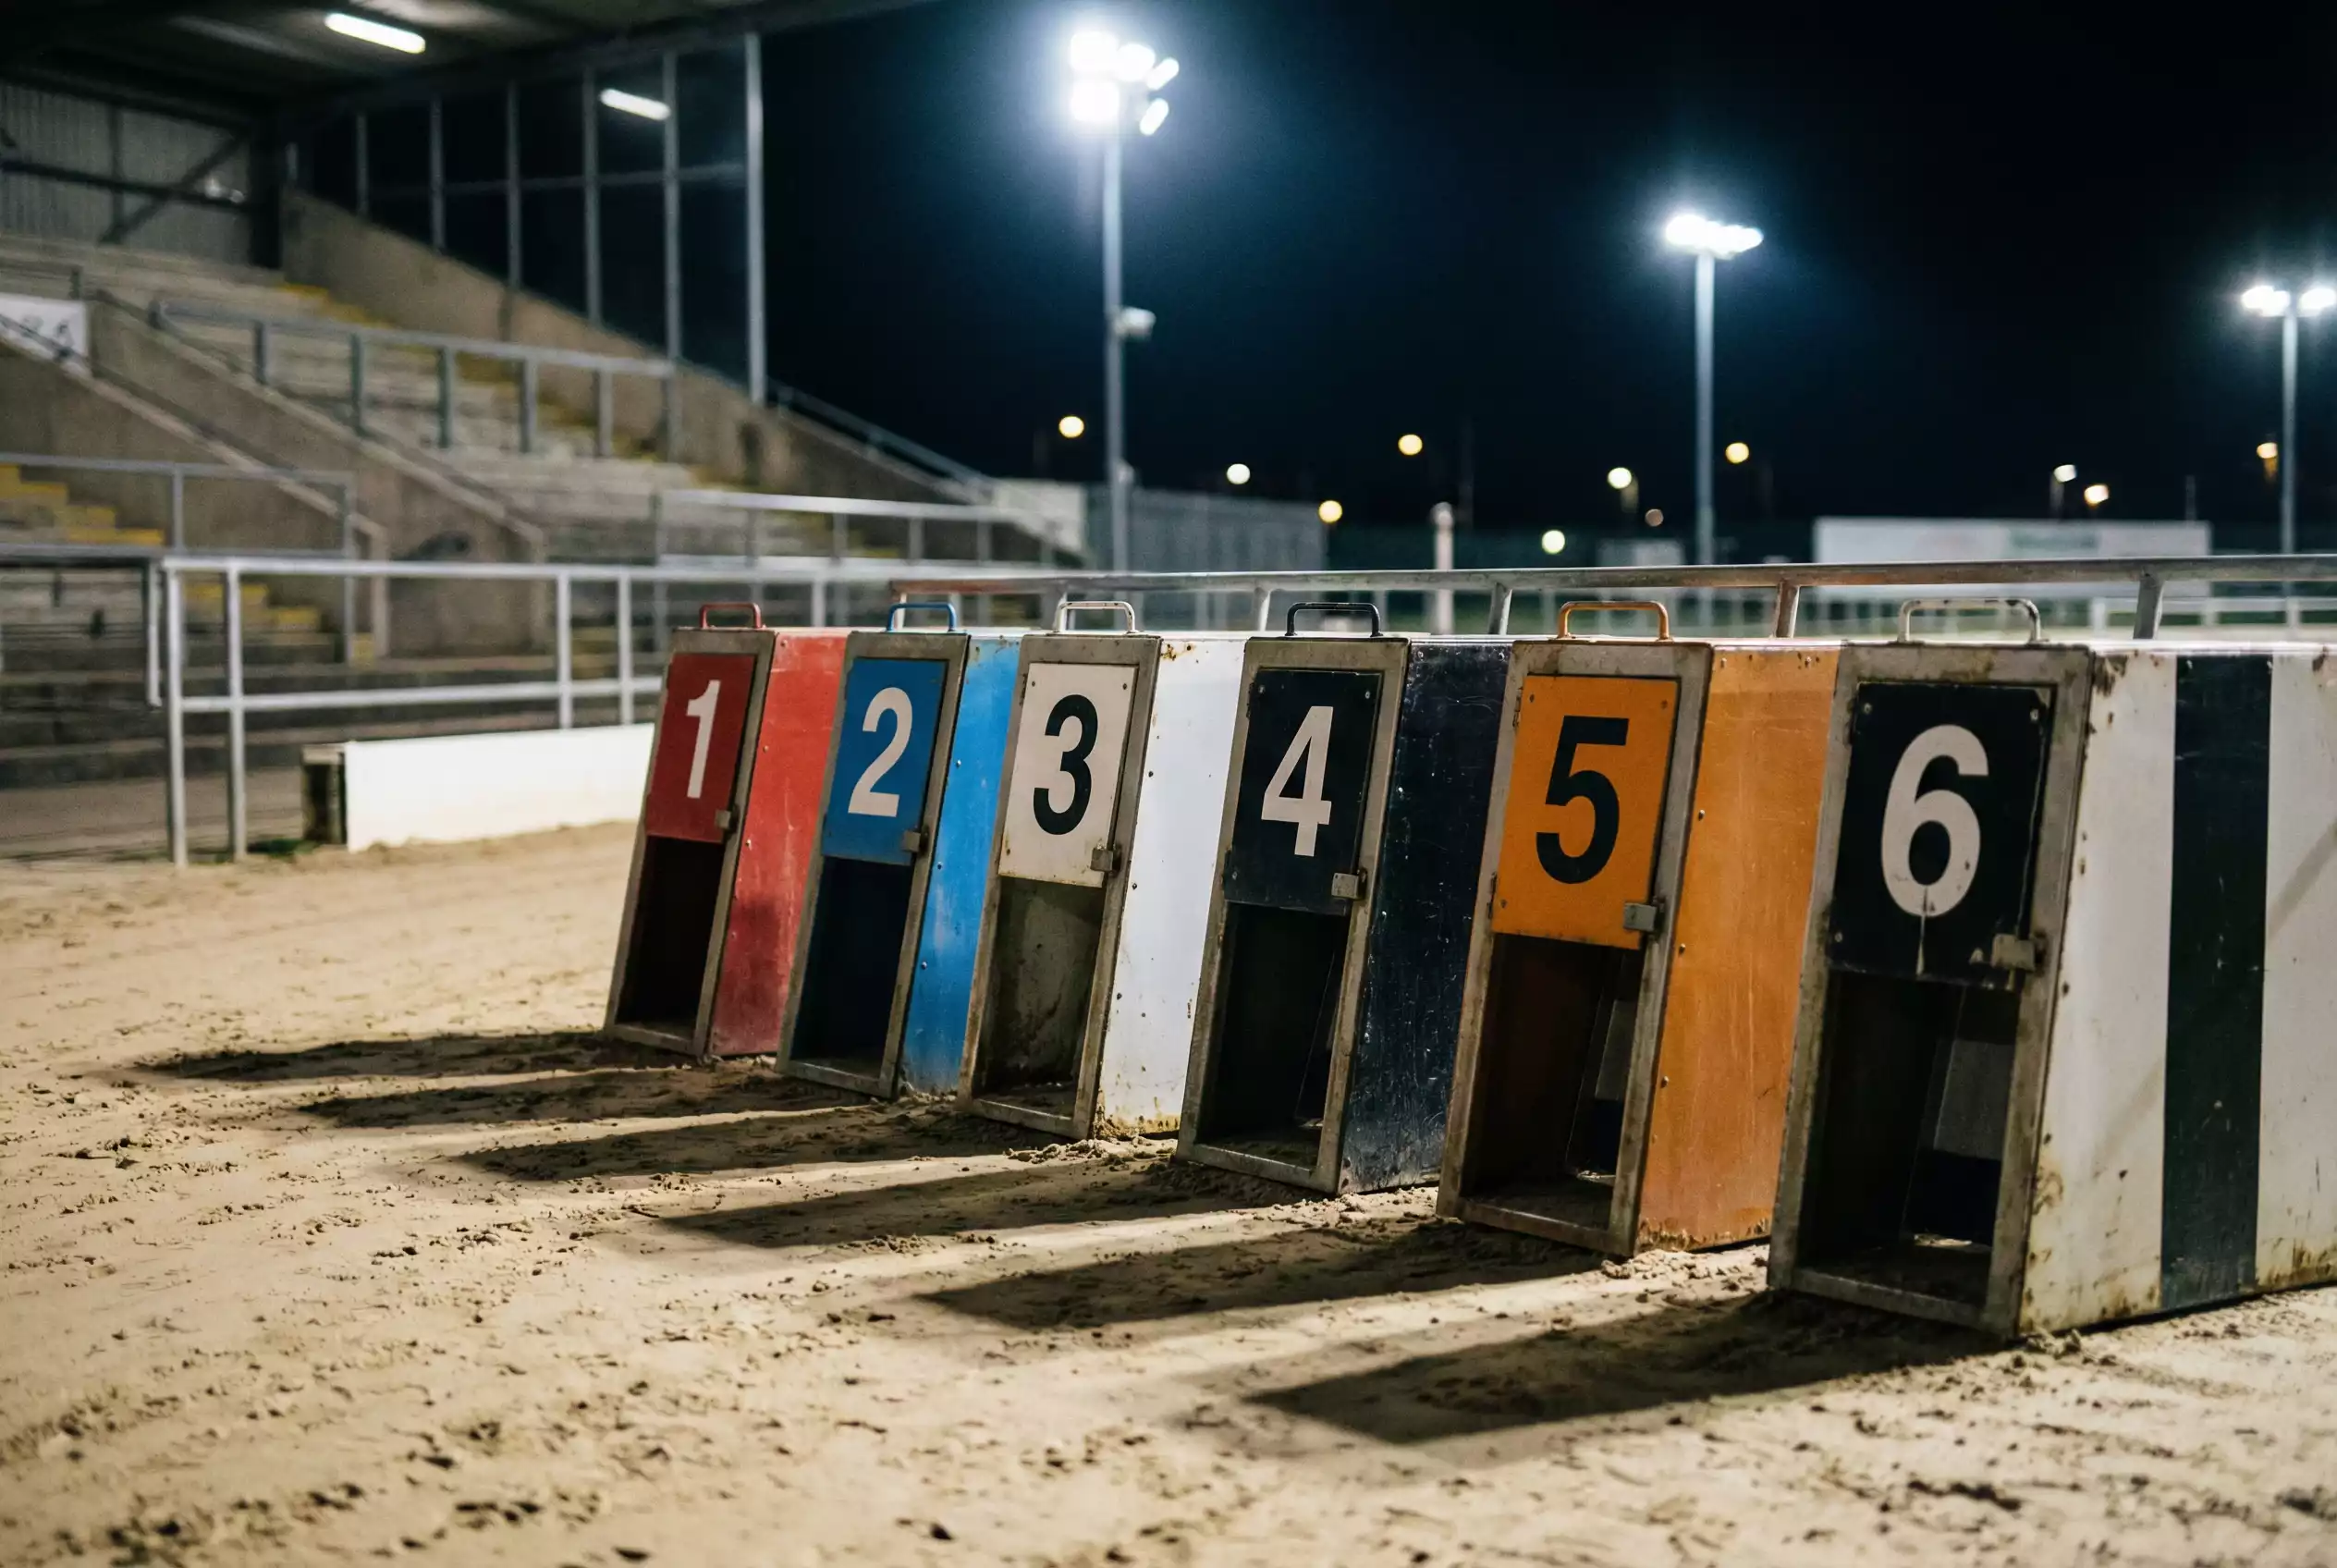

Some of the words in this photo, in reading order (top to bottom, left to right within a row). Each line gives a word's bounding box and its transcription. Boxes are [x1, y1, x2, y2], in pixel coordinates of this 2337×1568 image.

[687, 680, 720, 798] 1
[848, 688, 912, 817] 2
[1034, 694, 1097, 835] 3
[1261, 706, 1333, 856] 4
[1536, 716, 1629, 884] 5
[1882, 725, 1988, 918] 6
